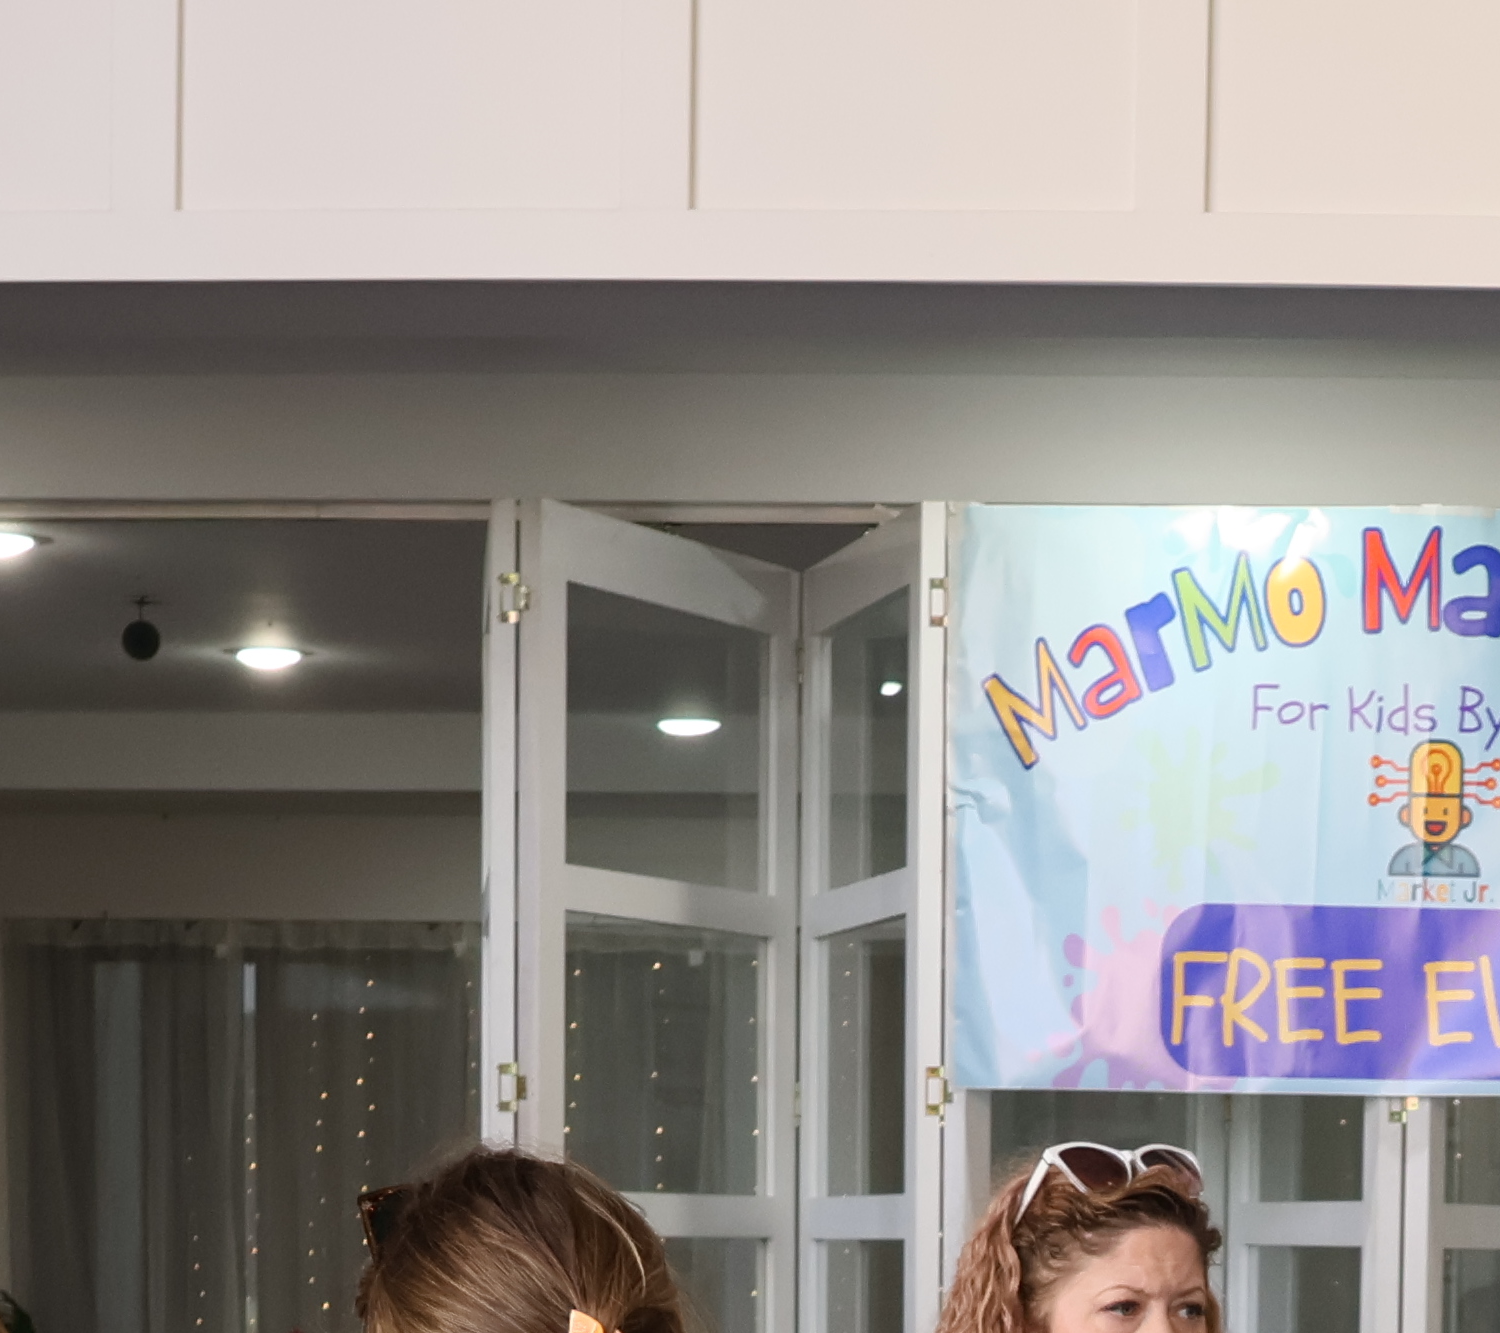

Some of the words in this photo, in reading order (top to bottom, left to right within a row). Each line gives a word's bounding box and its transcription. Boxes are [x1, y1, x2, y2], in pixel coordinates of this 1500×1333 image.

[981, 550, 1326, 770] MarMo
[1251, 684, 1329, 731] For
[1348, 683, 1438, 736] Kids
[1377, 878, 1457, 903] Market
[1463, 880, 1494, 903] Jr.
[1171, 947, 1383, 1047] FREE
